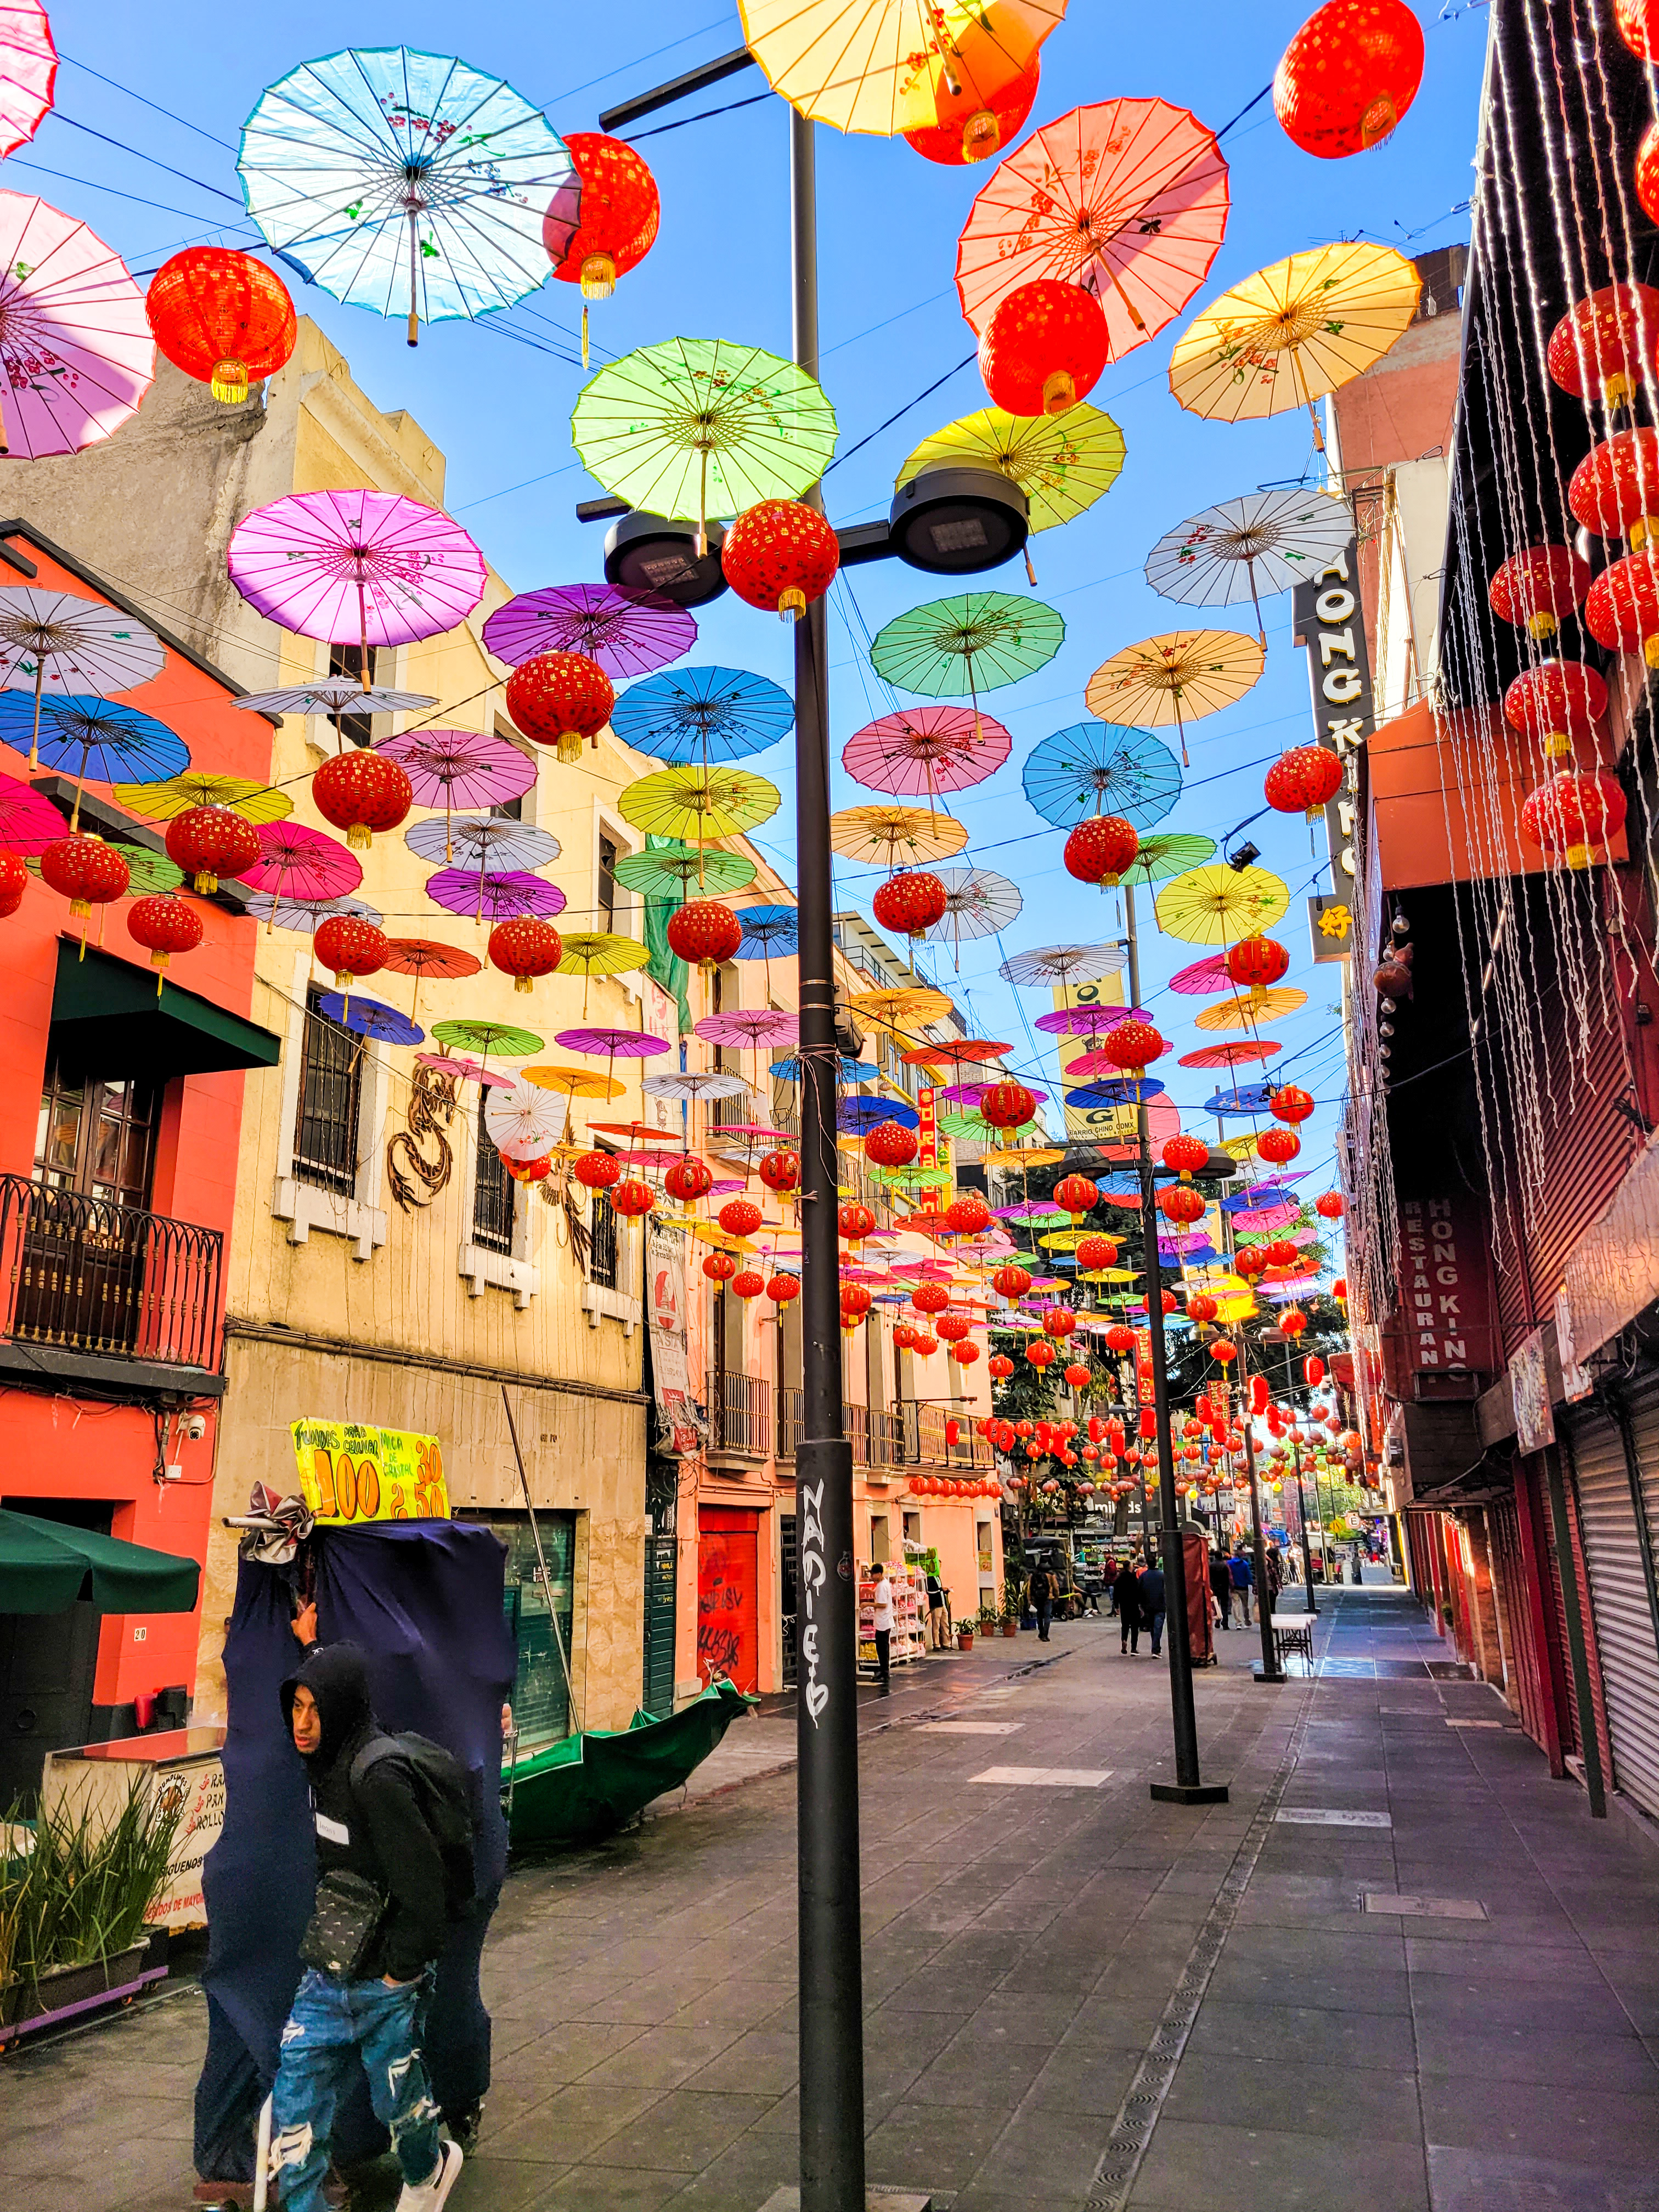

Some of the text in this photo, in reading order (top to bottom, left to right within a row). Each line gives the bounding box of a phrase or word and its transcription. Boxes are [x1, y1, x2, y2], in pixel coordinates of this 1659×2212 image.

[1317, 904, 1353, 940] 好
[1094, 1125, 1113, 1133] CHINO
[1116, 1122, 1135, 1130] CDMX
[1428, 1198, 1459, 1286] HONG
[295, 1421, 367, 1451] FUNDAS PARA
[380, 1432, 404, 1452] MICA
[343, 1439, 380, 1459] CELULAR
[389, 1452, 398, 1463] DE
[415, 1440, 443, 1486] 30
[311, 1449, 381, 1521] 100
[414, 1482, 444, 1519] 50
[1350, 1517, 1357, 1525] E
[135, 1629, 145, 1640] 20
[158, 1773, 188, 1795] DUMPLINGS
[319, 1820, 336, 1835] Jeans
[173, 1898, 183, 1912] DE
